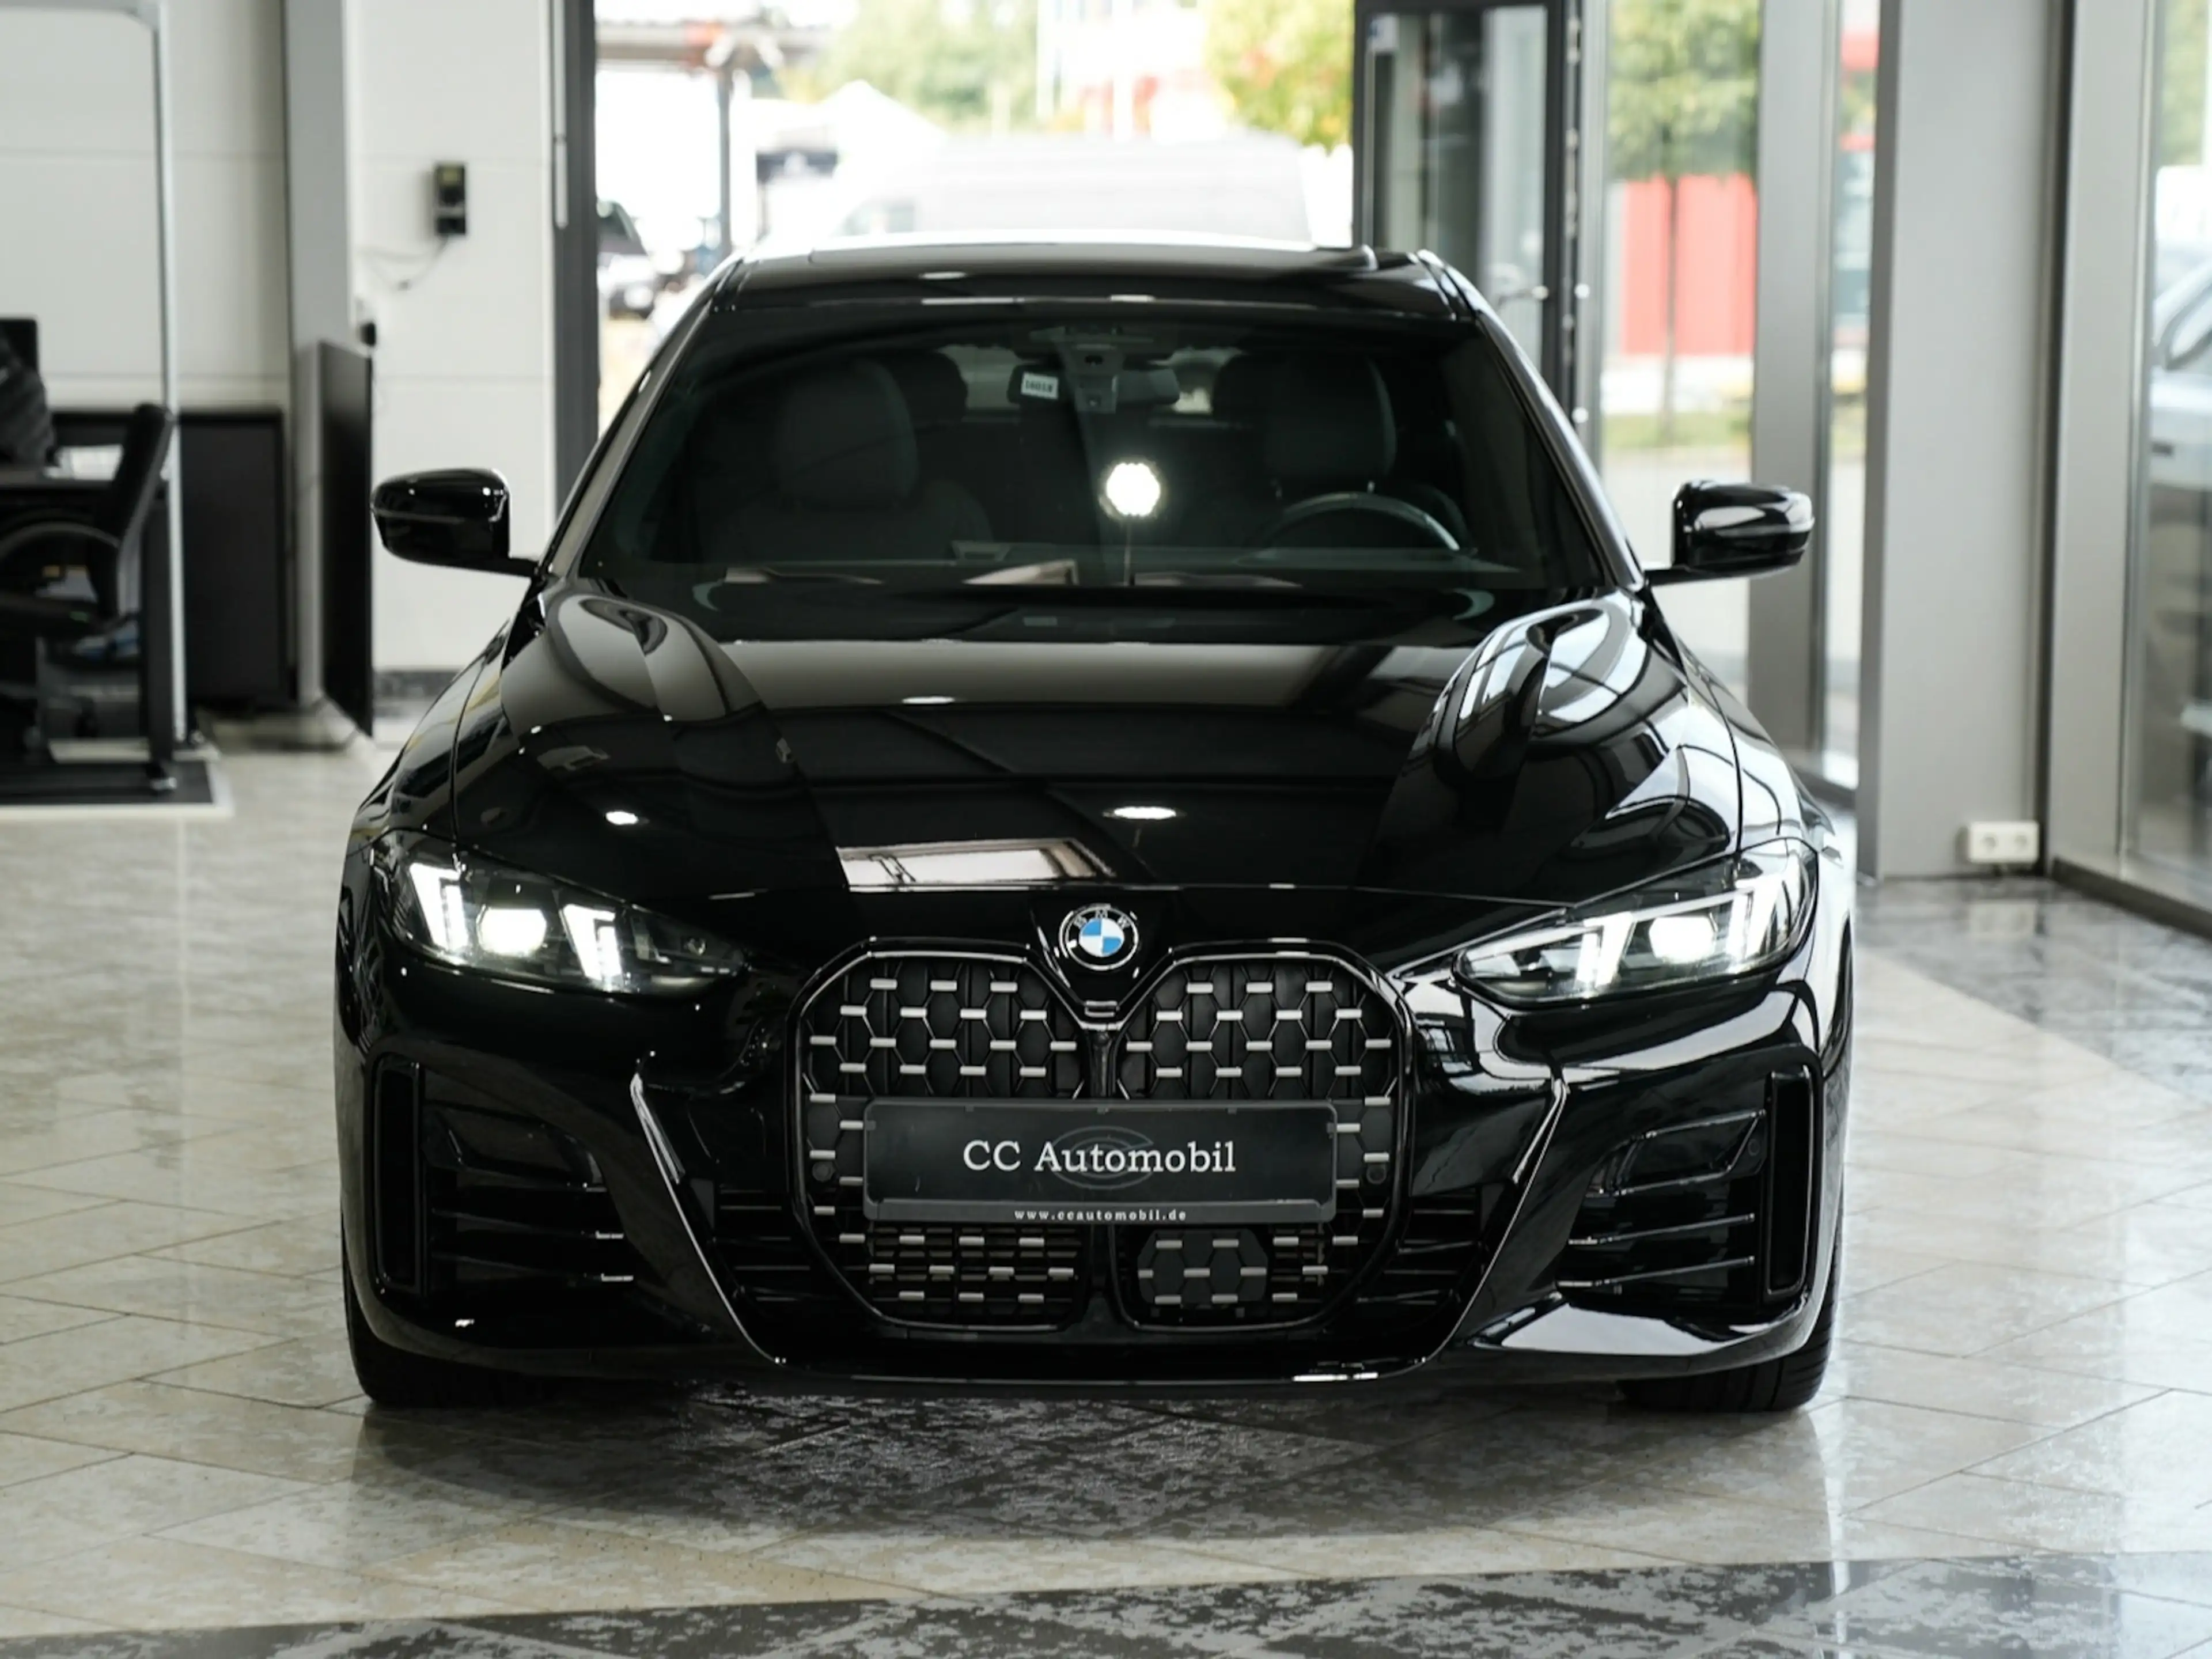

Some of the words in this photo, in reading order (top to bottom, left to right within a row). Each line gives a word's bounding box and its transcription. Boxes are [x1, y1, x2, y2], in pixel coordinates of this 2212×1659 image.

[1073, 908, 1130, 930] BMW
[963, 1139, 1021, 1171] CC
[1033, 1140, 1236, 1172] Automobil
[1014, 1209, 1186, 1221] www.ccautomobil.de
